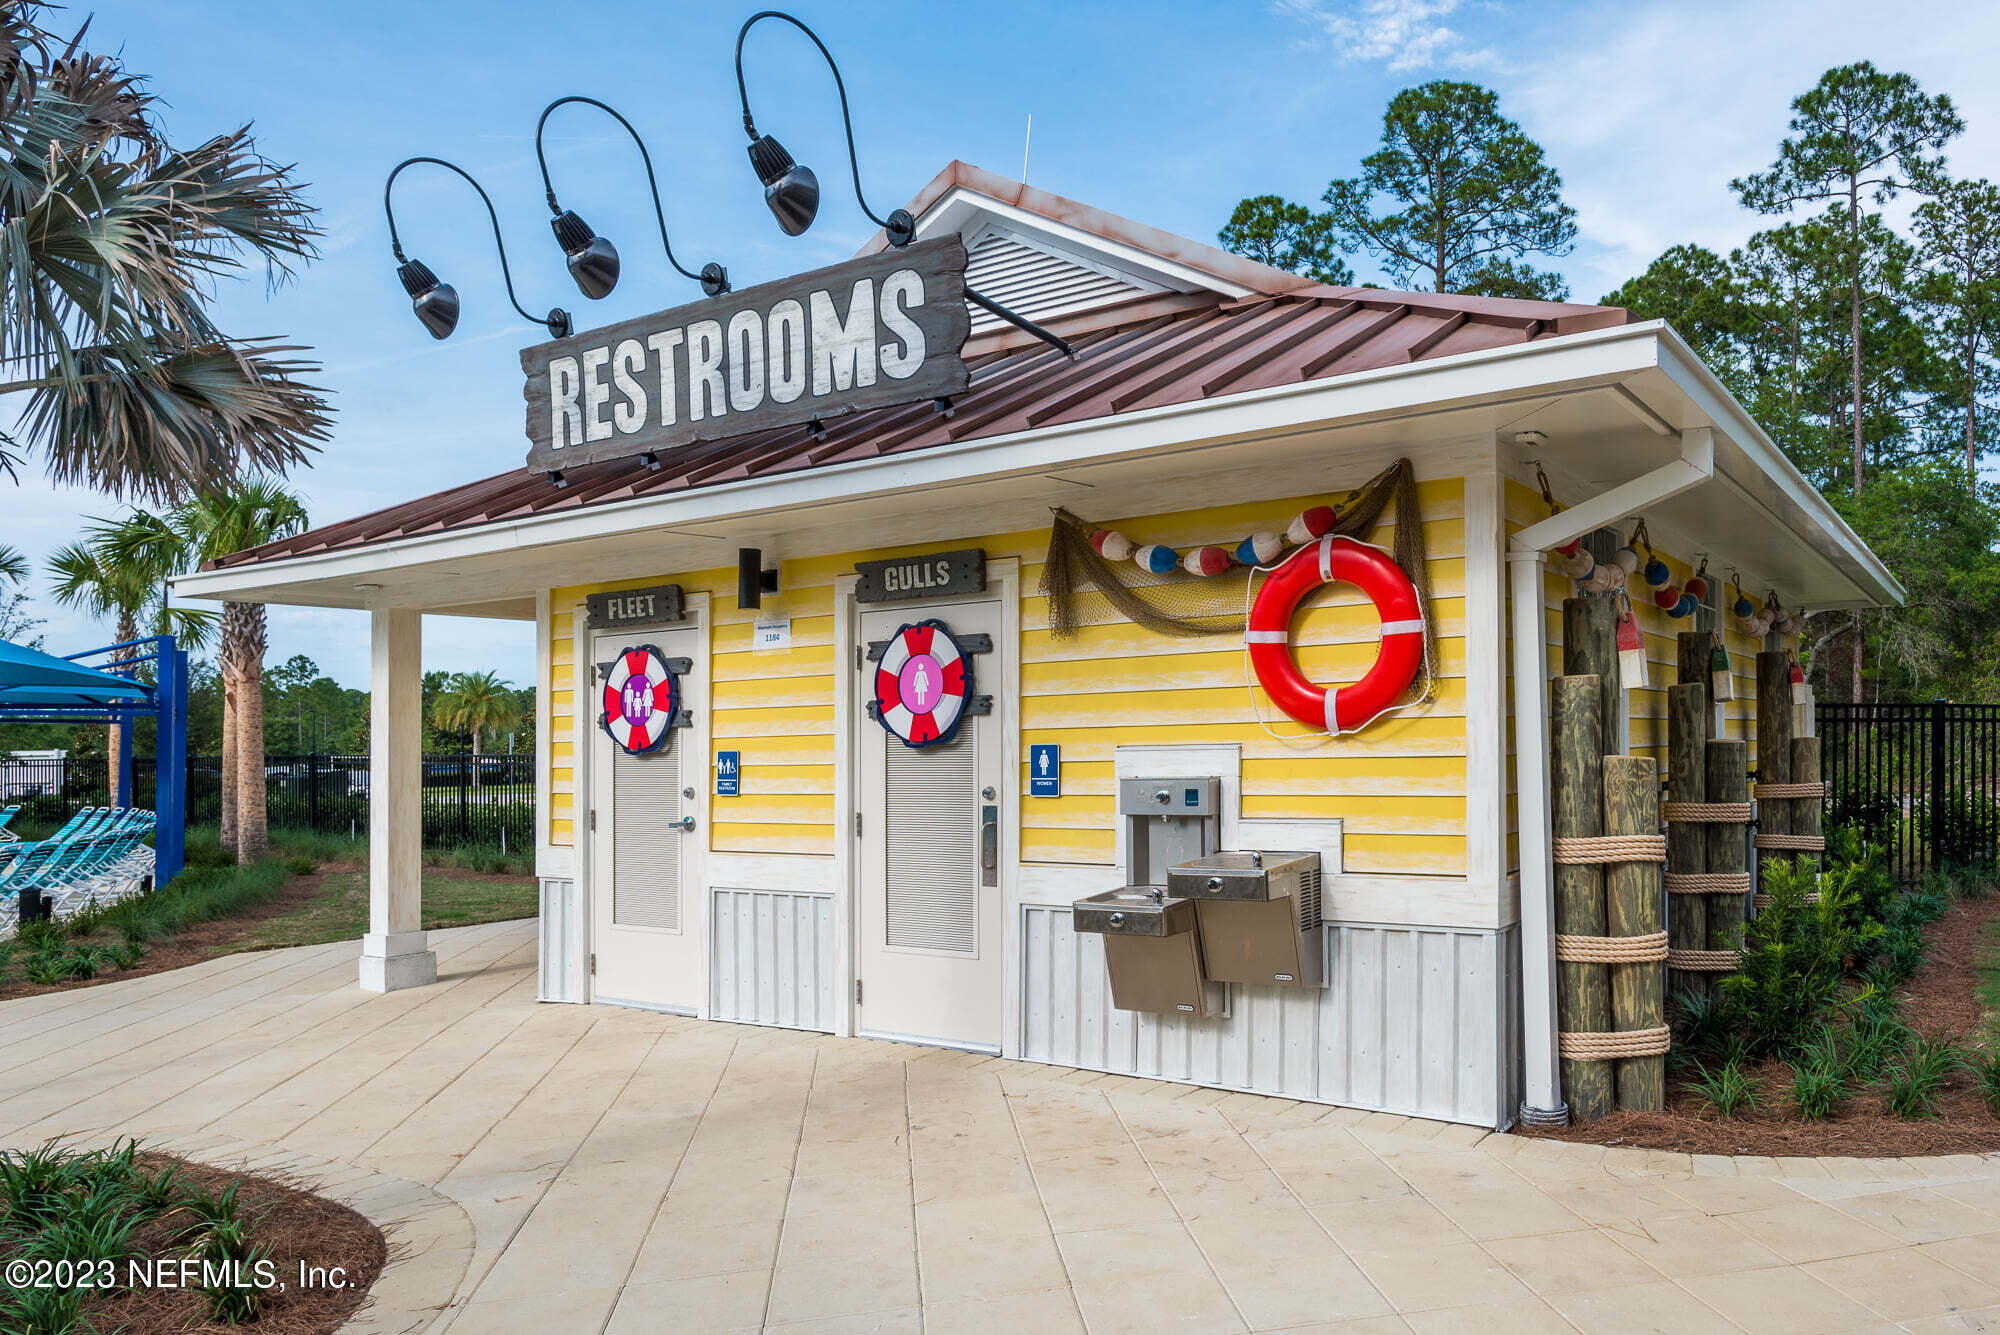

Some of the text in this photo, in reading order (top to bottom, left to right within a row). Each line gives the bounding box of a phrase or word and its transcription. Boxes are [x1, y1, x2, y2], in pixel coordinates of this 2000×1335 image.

[549, 268, 926, 450] RESTROOMS
[884, 560, 951, 592] GULLS
[608, 594, 656, 620] FLEET
